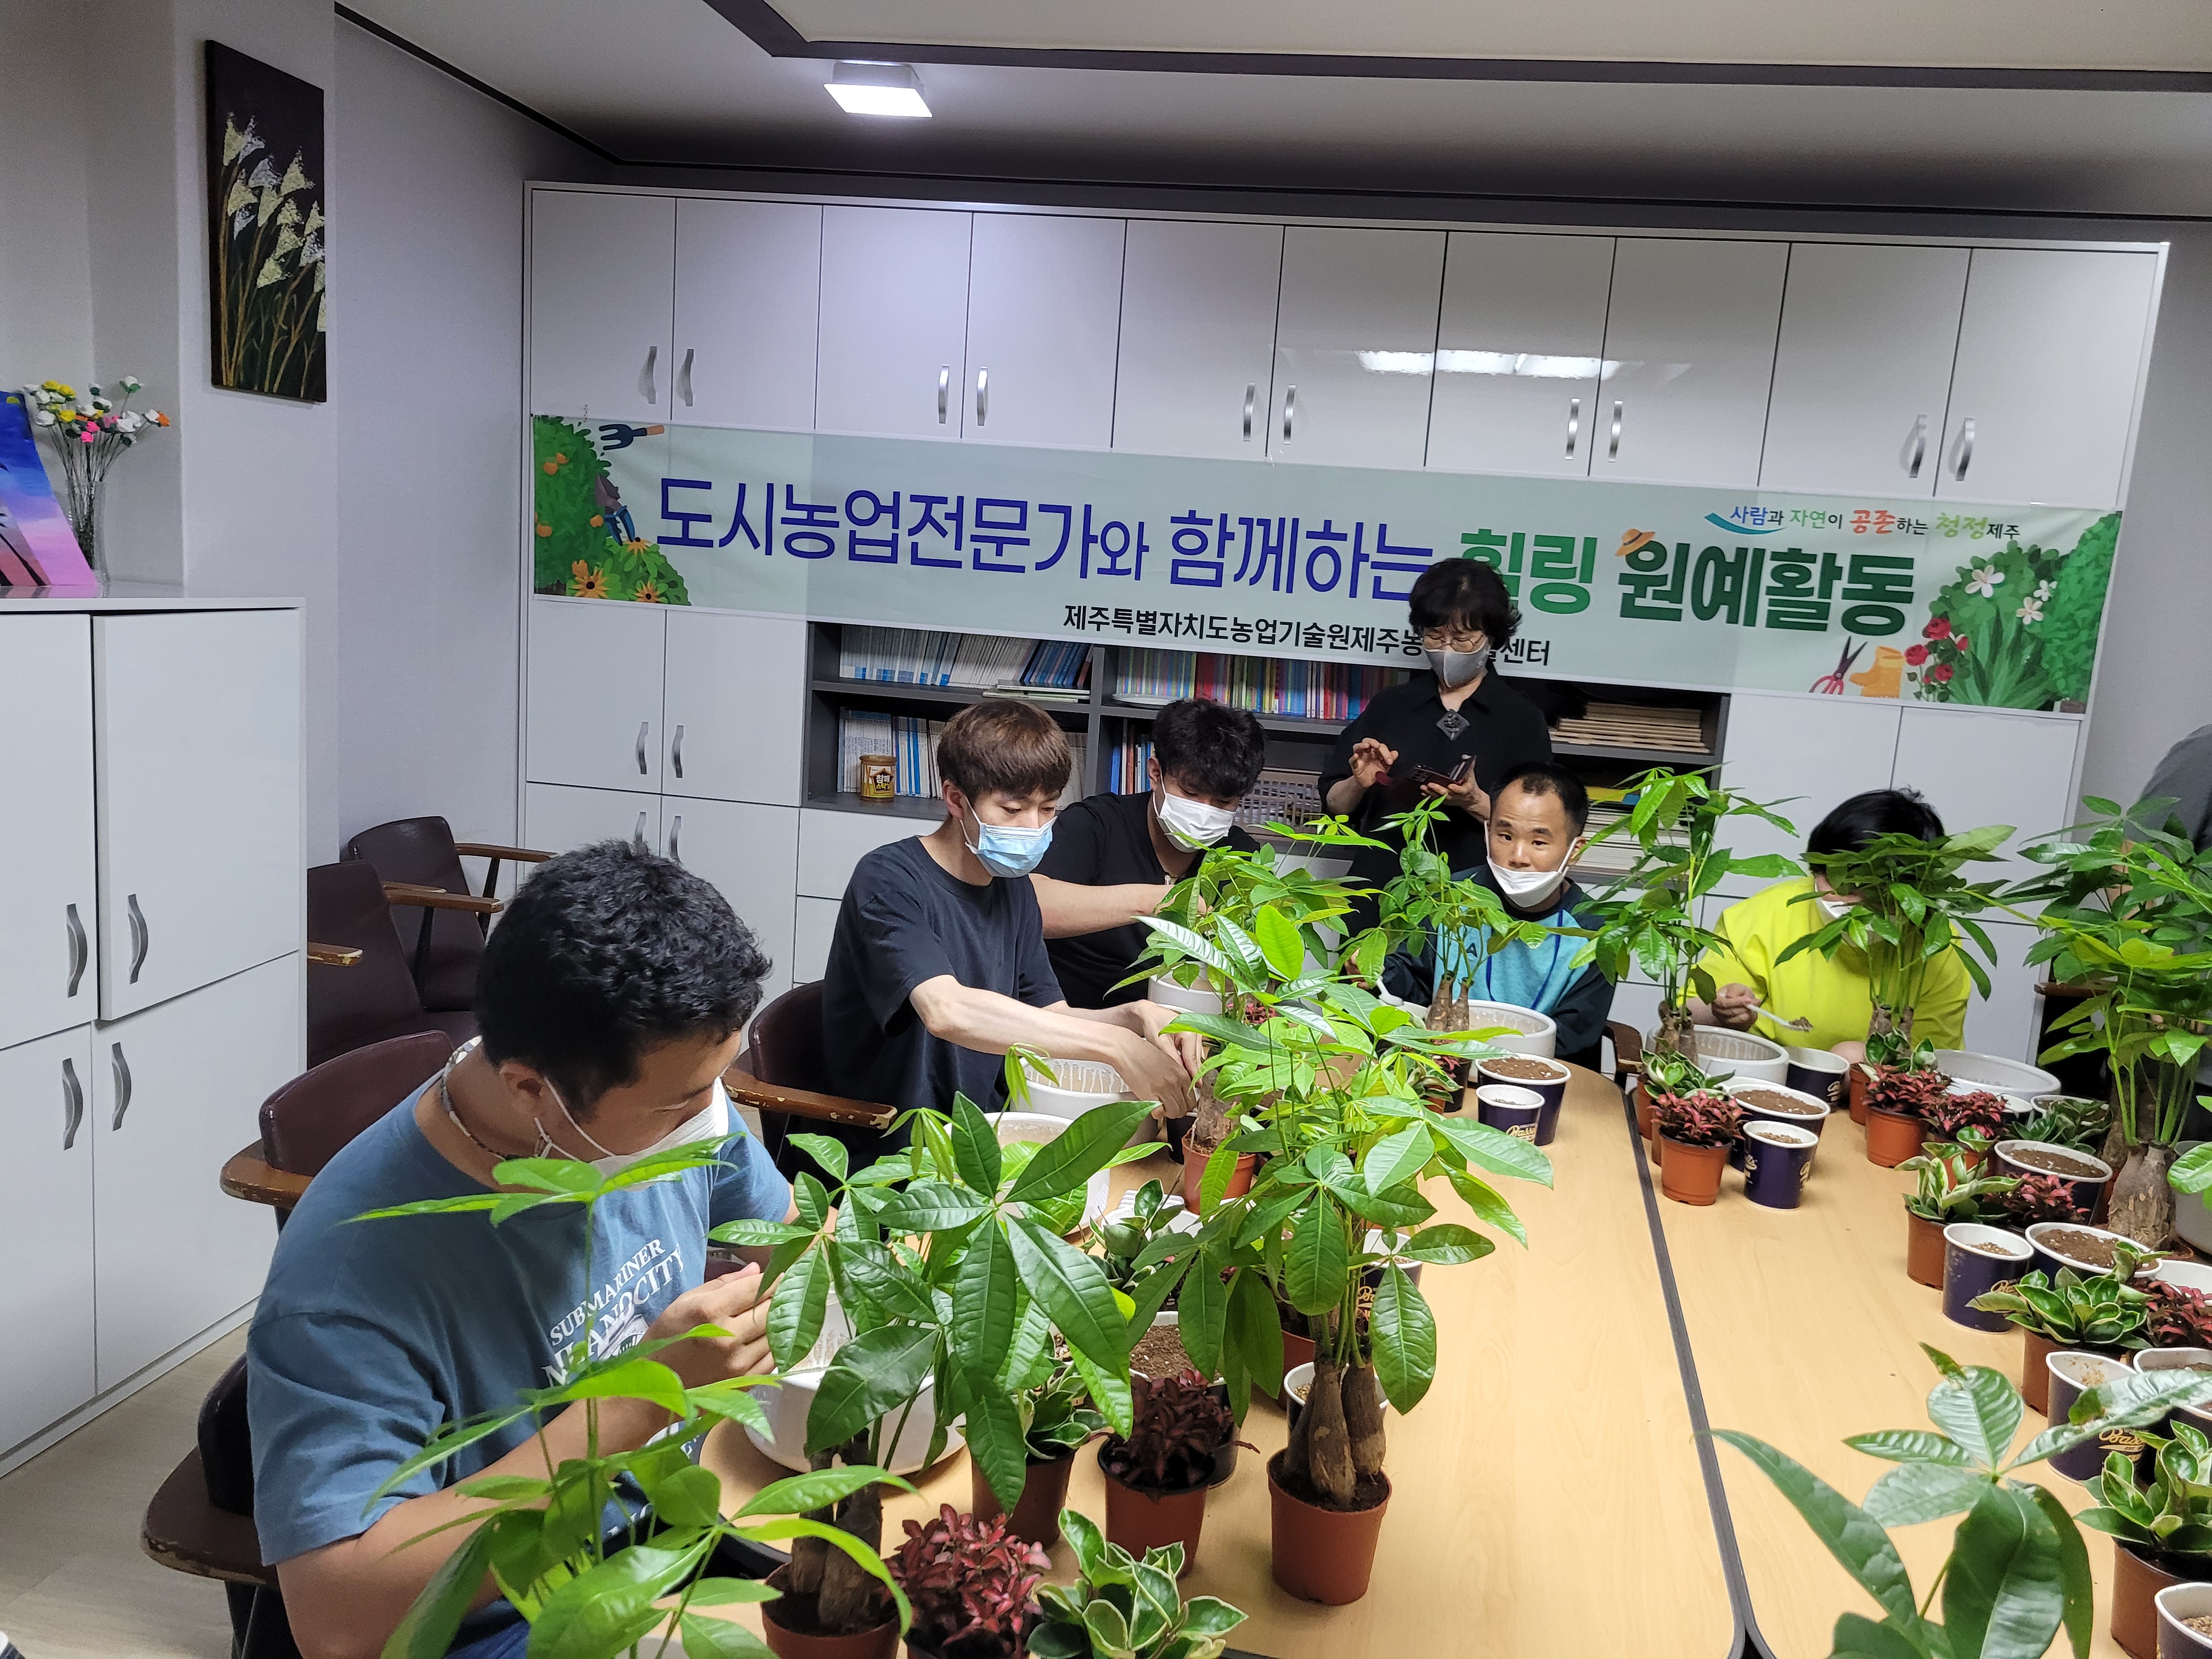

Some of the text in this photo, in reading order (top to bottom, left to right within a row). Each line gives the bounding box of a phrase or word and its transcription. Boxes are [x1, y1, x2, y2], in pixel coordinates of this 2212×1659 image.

[657, 478, 1149, 581] 도시농업전문가와
[1170, 510, 1434, 601] 함께하는
[1618, 540, 1915, 636] 원예활동
[1730, 506, 2021, 540] 사람과 자연이 공존하는 청정제주
[1063, 605, 1550, 666] 제주특별자치도농업기술원제주농센터
[550, 1239, 666, 1346] SUBMARINER
